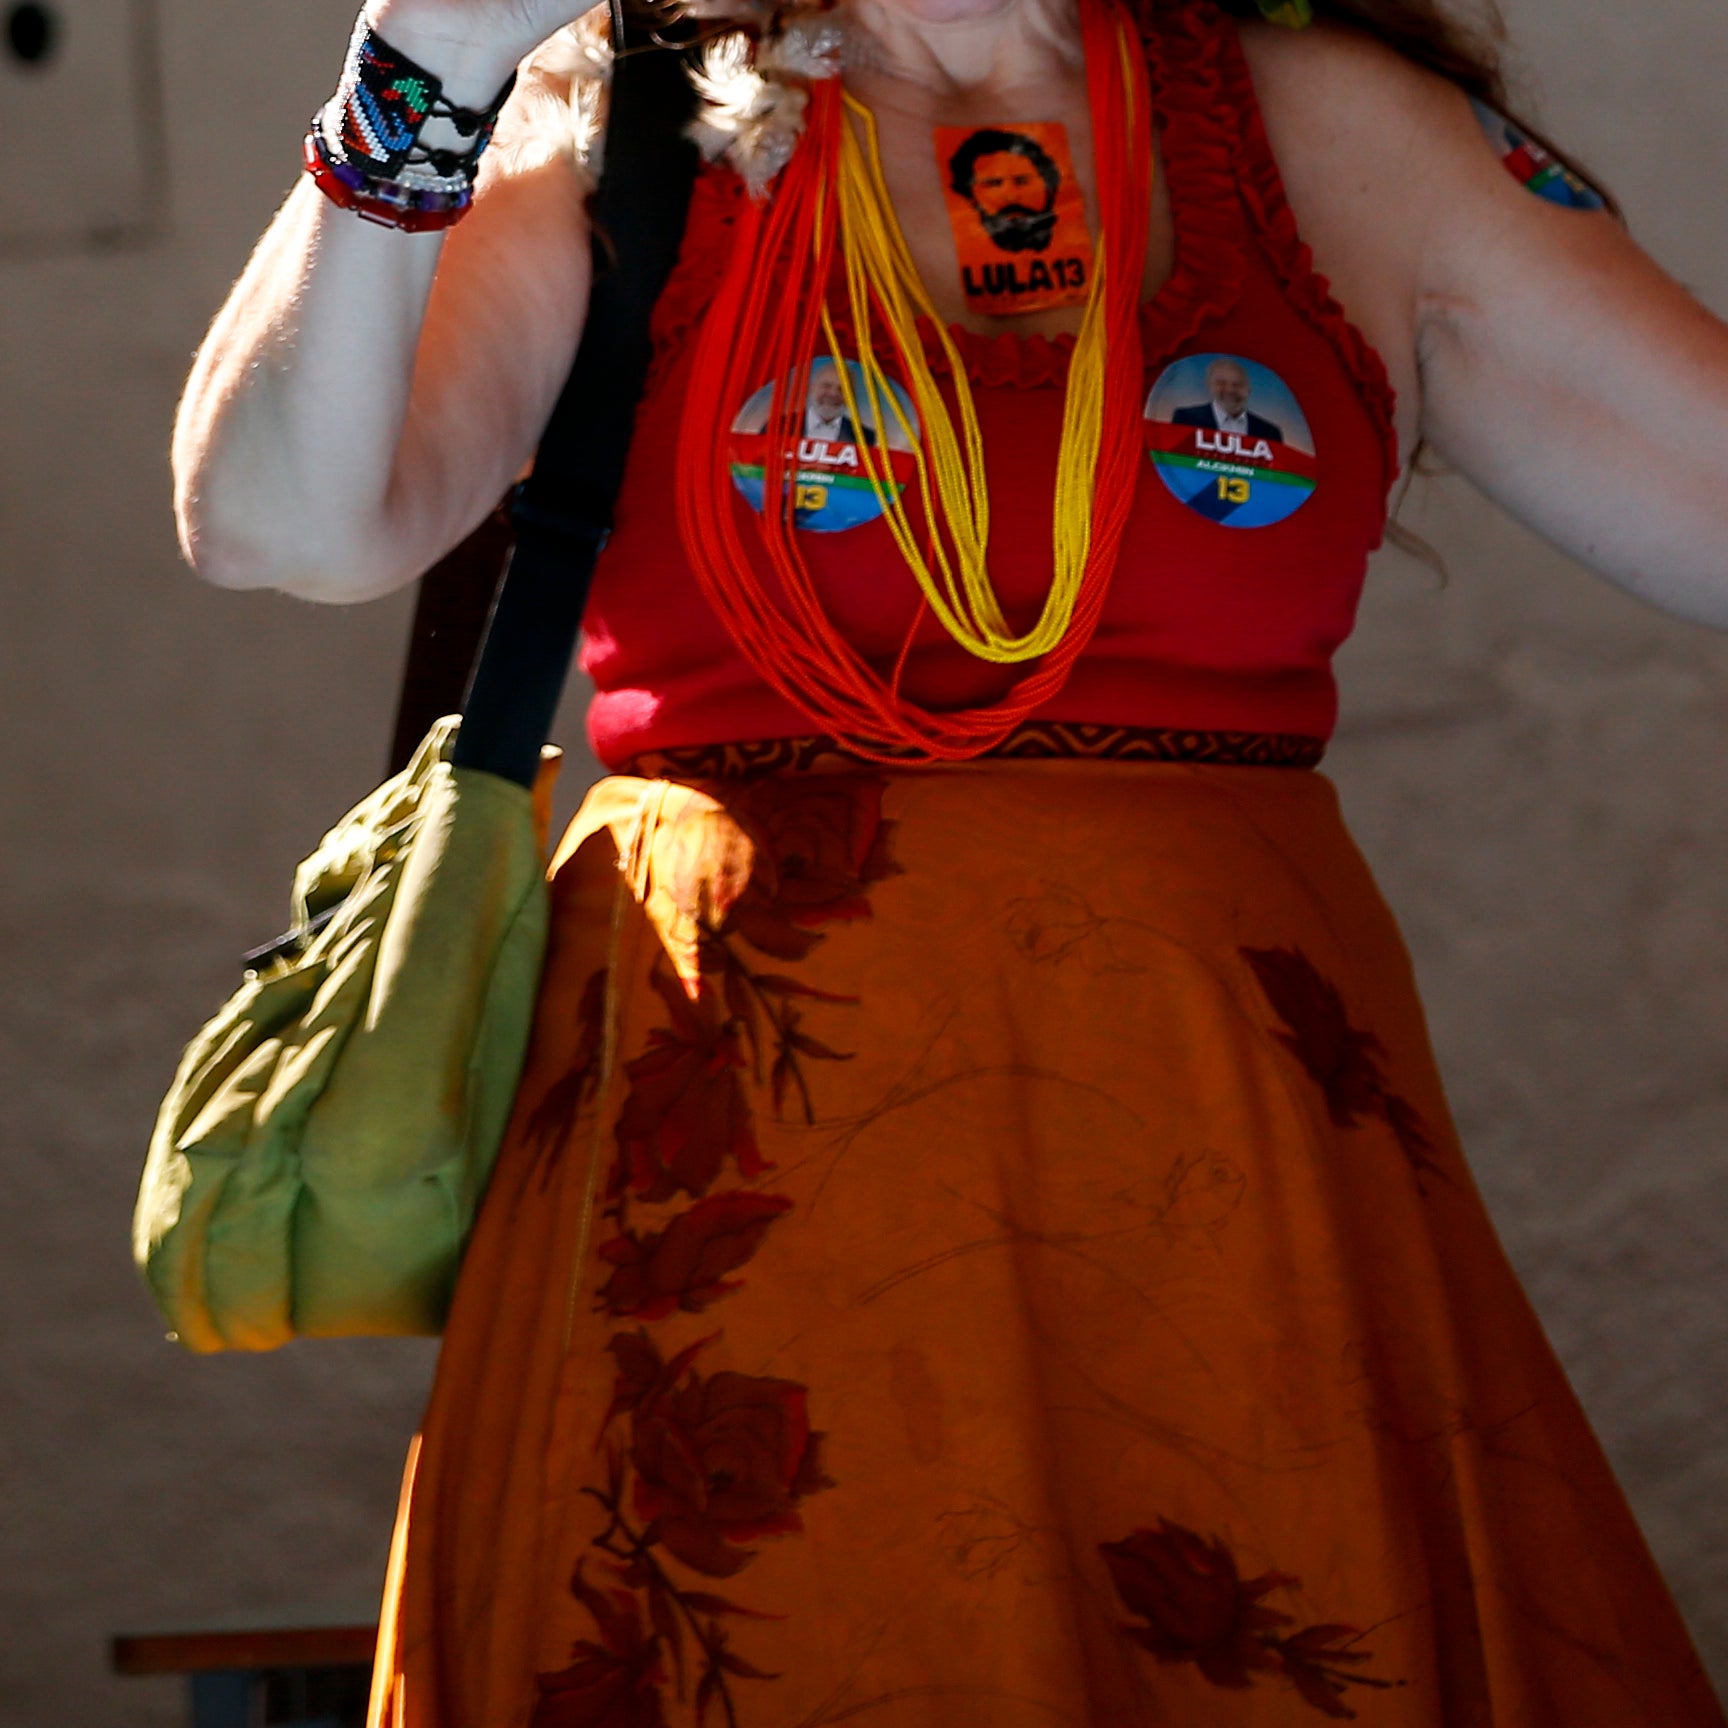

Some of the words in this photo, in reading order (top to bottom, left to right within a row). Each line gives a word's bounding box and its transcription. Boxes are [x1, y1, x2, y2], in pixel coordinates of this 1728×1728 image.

[784, 439, 859, 467] ULA
[1195, 427, 1274, 461] LULA
[795, 484, 828, 511] 13
[1217, 475, 1250, 504] 13
